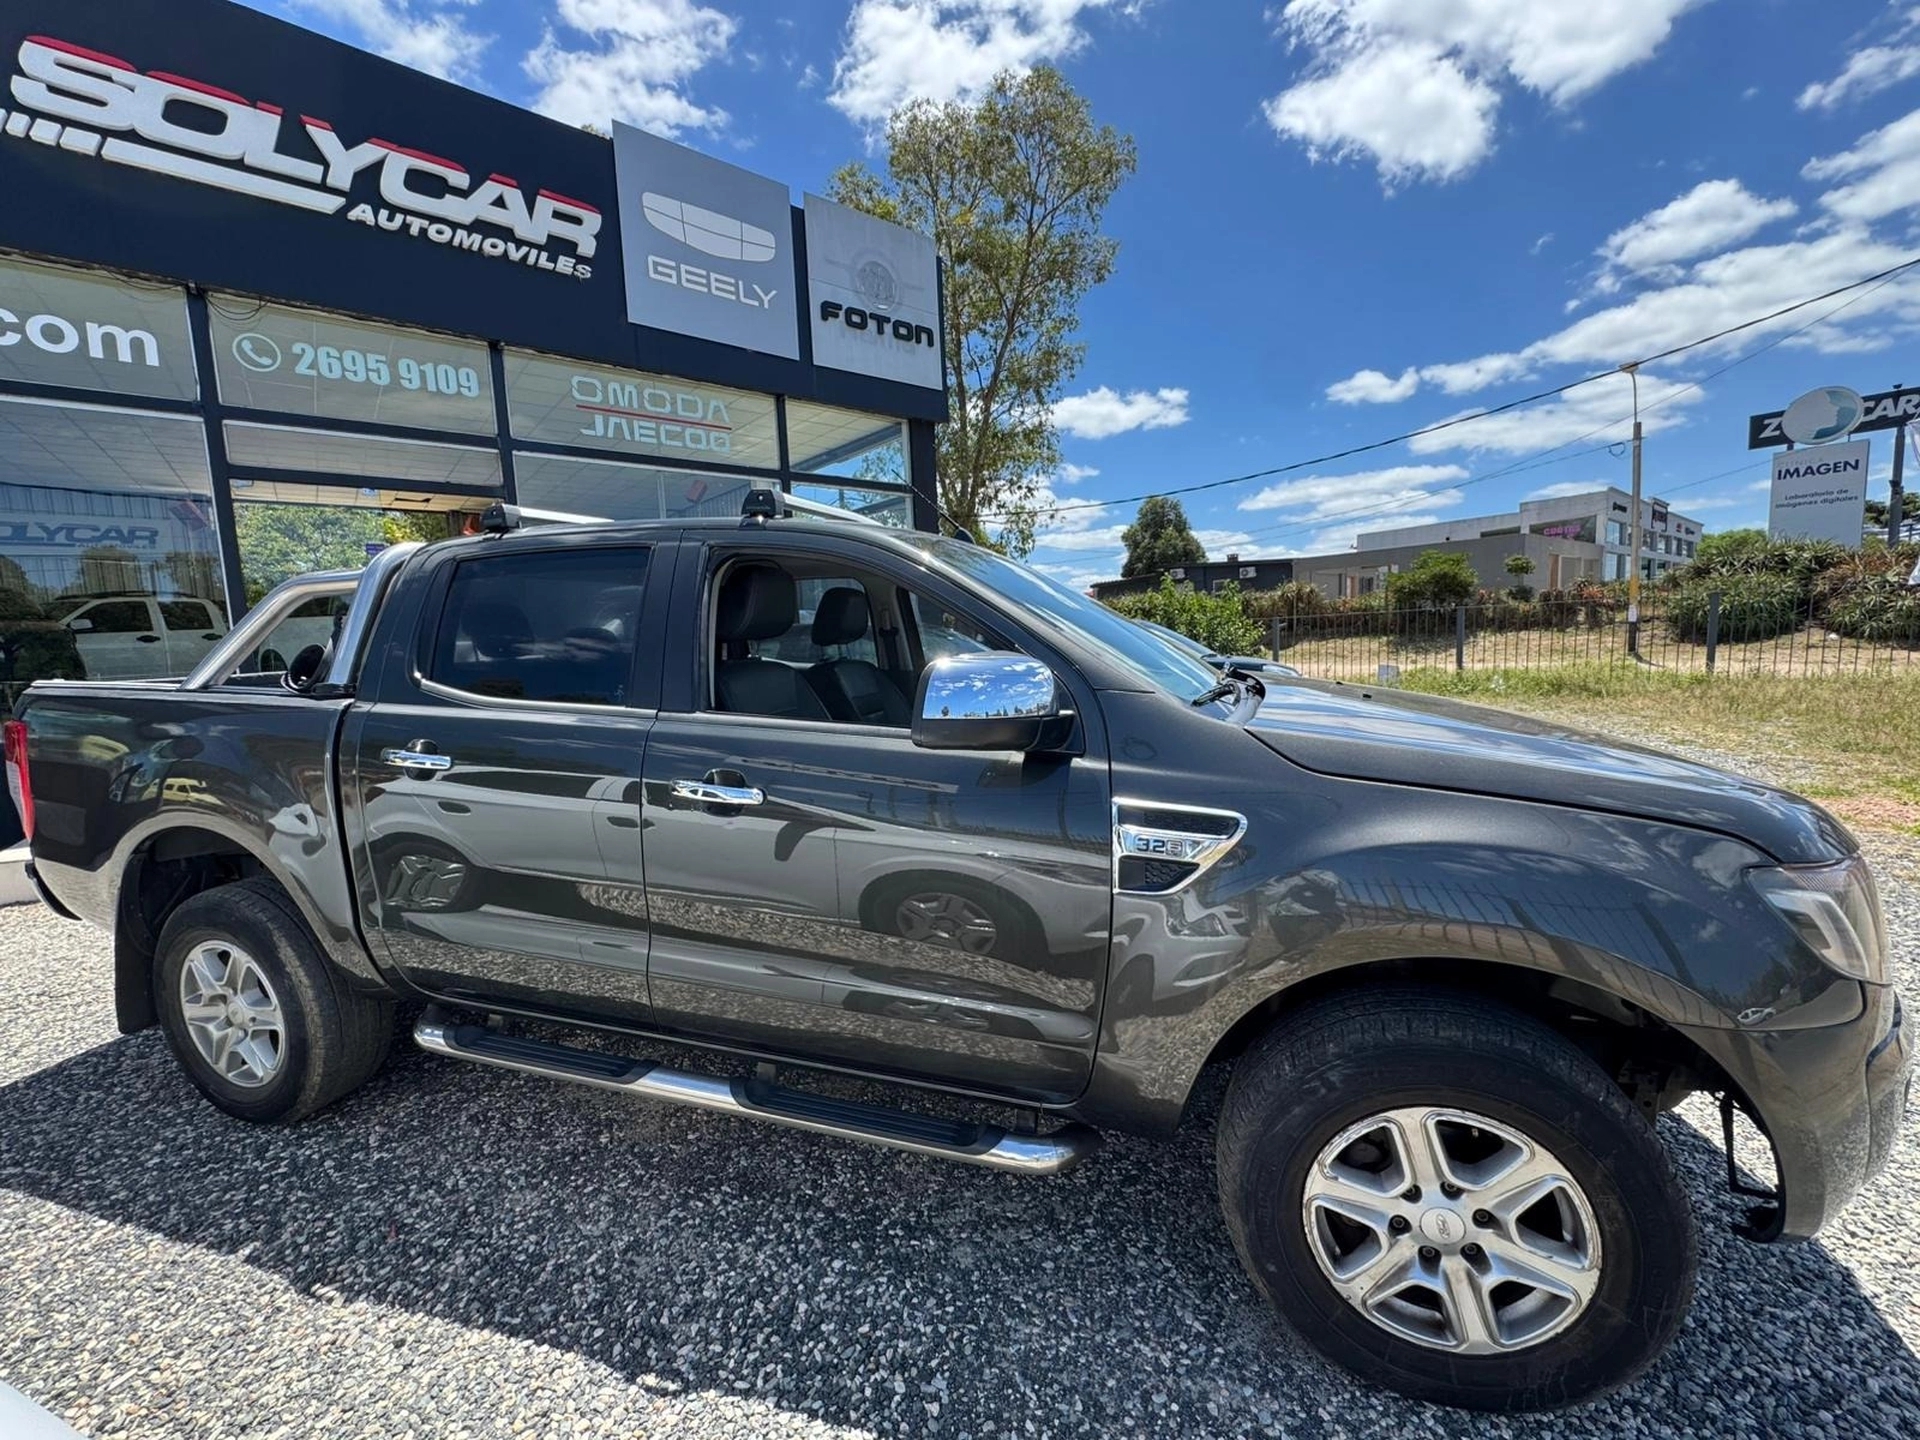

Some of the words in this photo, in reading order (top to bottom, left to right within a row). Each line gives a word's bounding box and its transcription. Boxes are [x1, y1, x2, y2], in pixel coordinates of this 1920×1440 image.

[9, 34, 602, 258] SOLYCAR
[346, 203, 593, 279] AUTOMOVILES
[647, 254, 778, 309] GEELY
[291, 342, 392, 386] 2695
[397, 357, 480, 398] 9109
[571, 375, 730, 423] OMODA
[1777, 459, 1860, 480] IMAGEN
